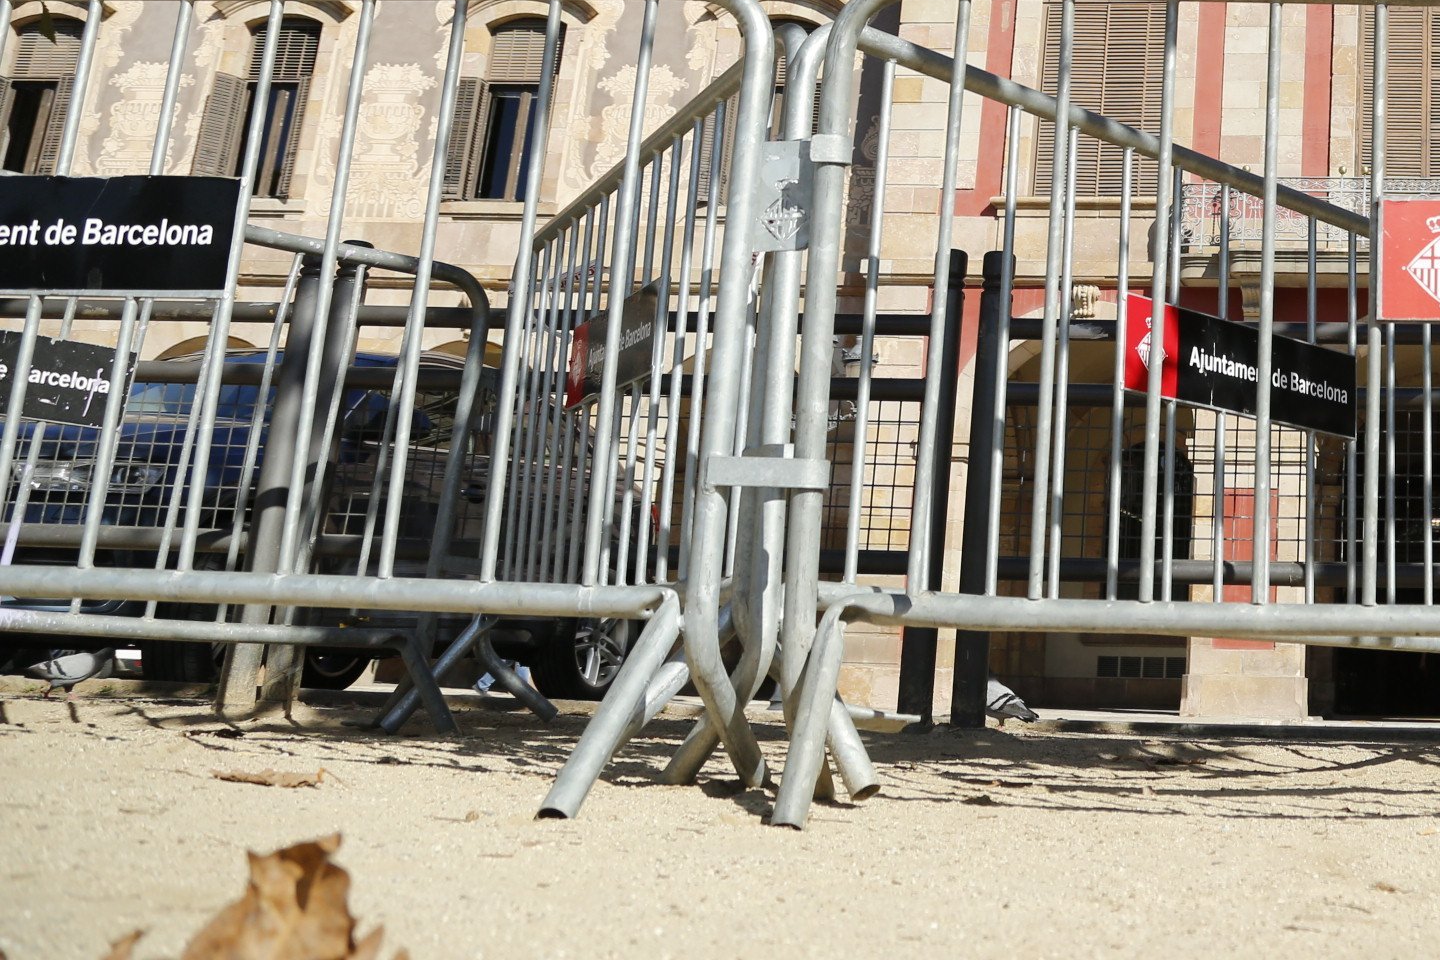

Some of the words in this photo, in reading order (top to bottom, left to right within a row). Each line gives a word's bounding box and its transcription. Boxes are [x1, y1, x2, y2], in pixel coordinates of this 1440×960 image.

[45, 218, 77, 246] de
[82, 218, 213, 246] Barcelona
[28, 364, 111, 394] arcelona
[1189, 346, 1258, 383] Ajuntame
[1272, 368, 1288, 389] de
[1290, 371, 1348, 404] Barcelona
